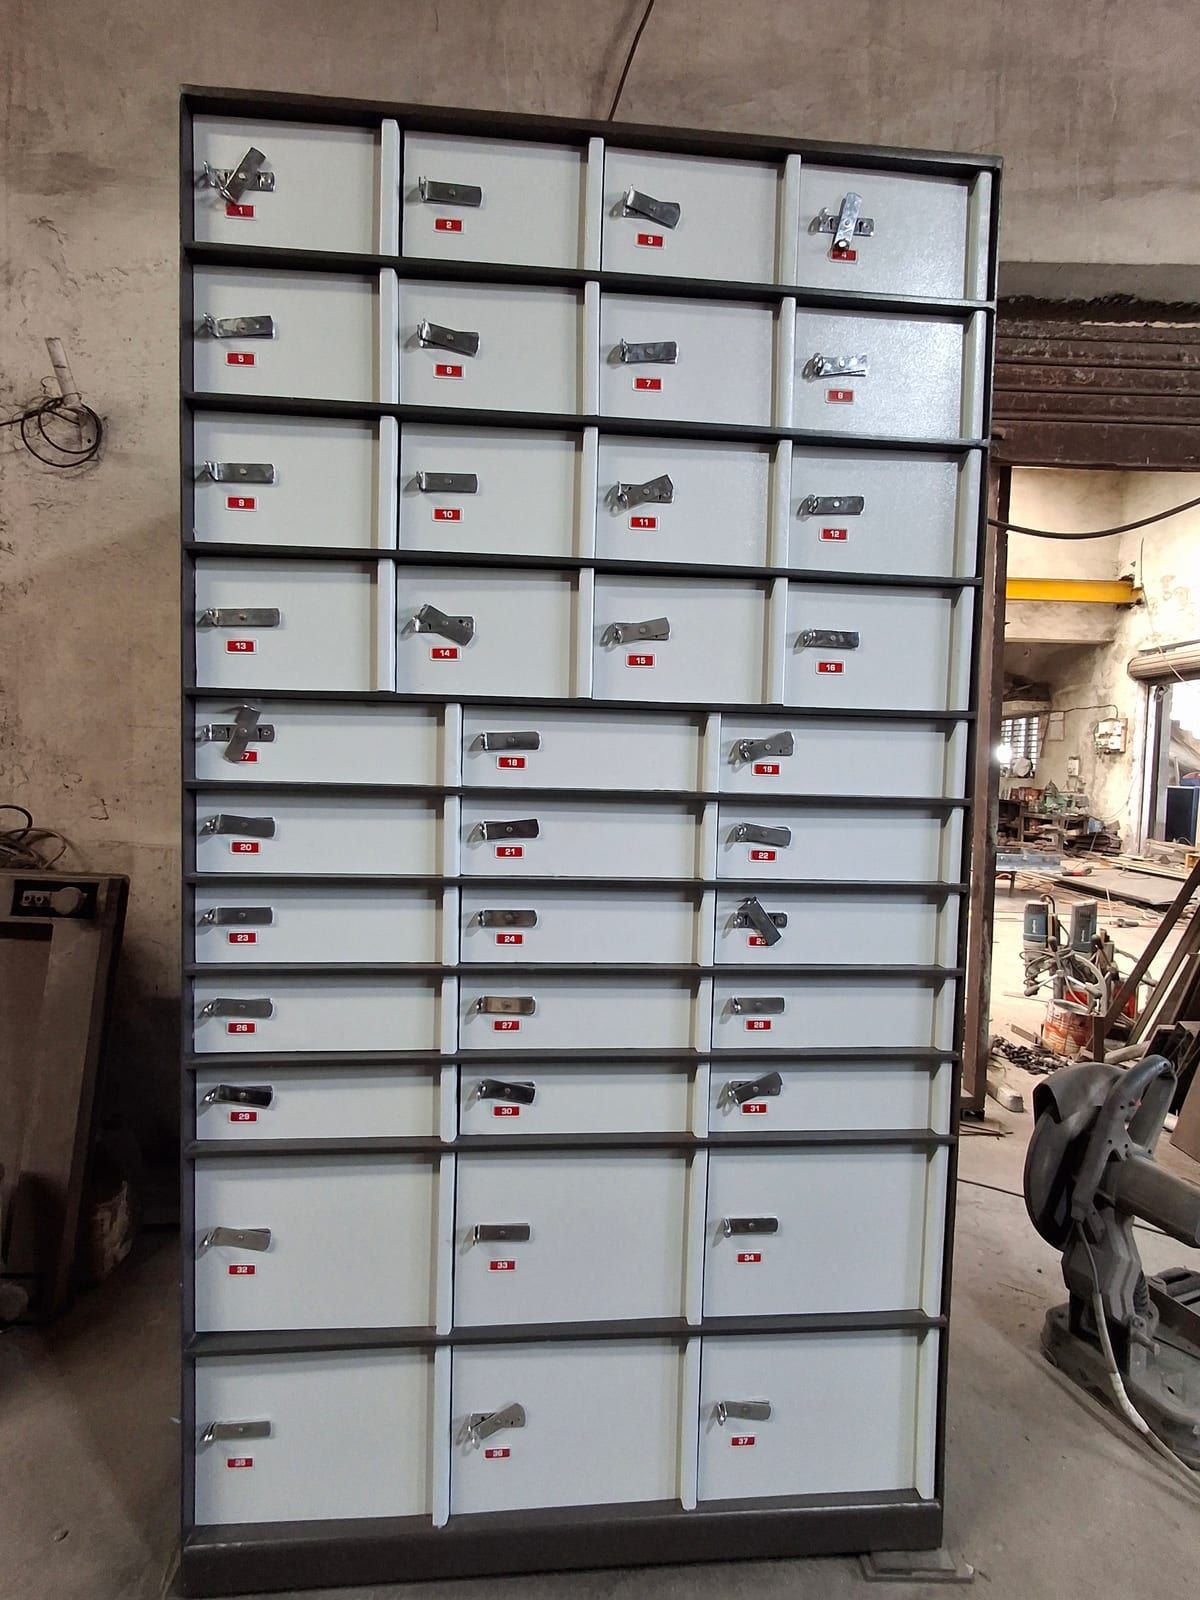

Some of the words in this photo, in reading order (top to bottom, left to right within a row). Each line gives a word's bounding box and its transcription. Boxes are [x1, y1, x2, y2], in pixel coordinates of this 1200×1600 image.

[239, 207, 243, 215] 1
[446, 221, 452, 229] 2
[647, 236, 653, 244] 3
[830, 530, 840, 538] 12
